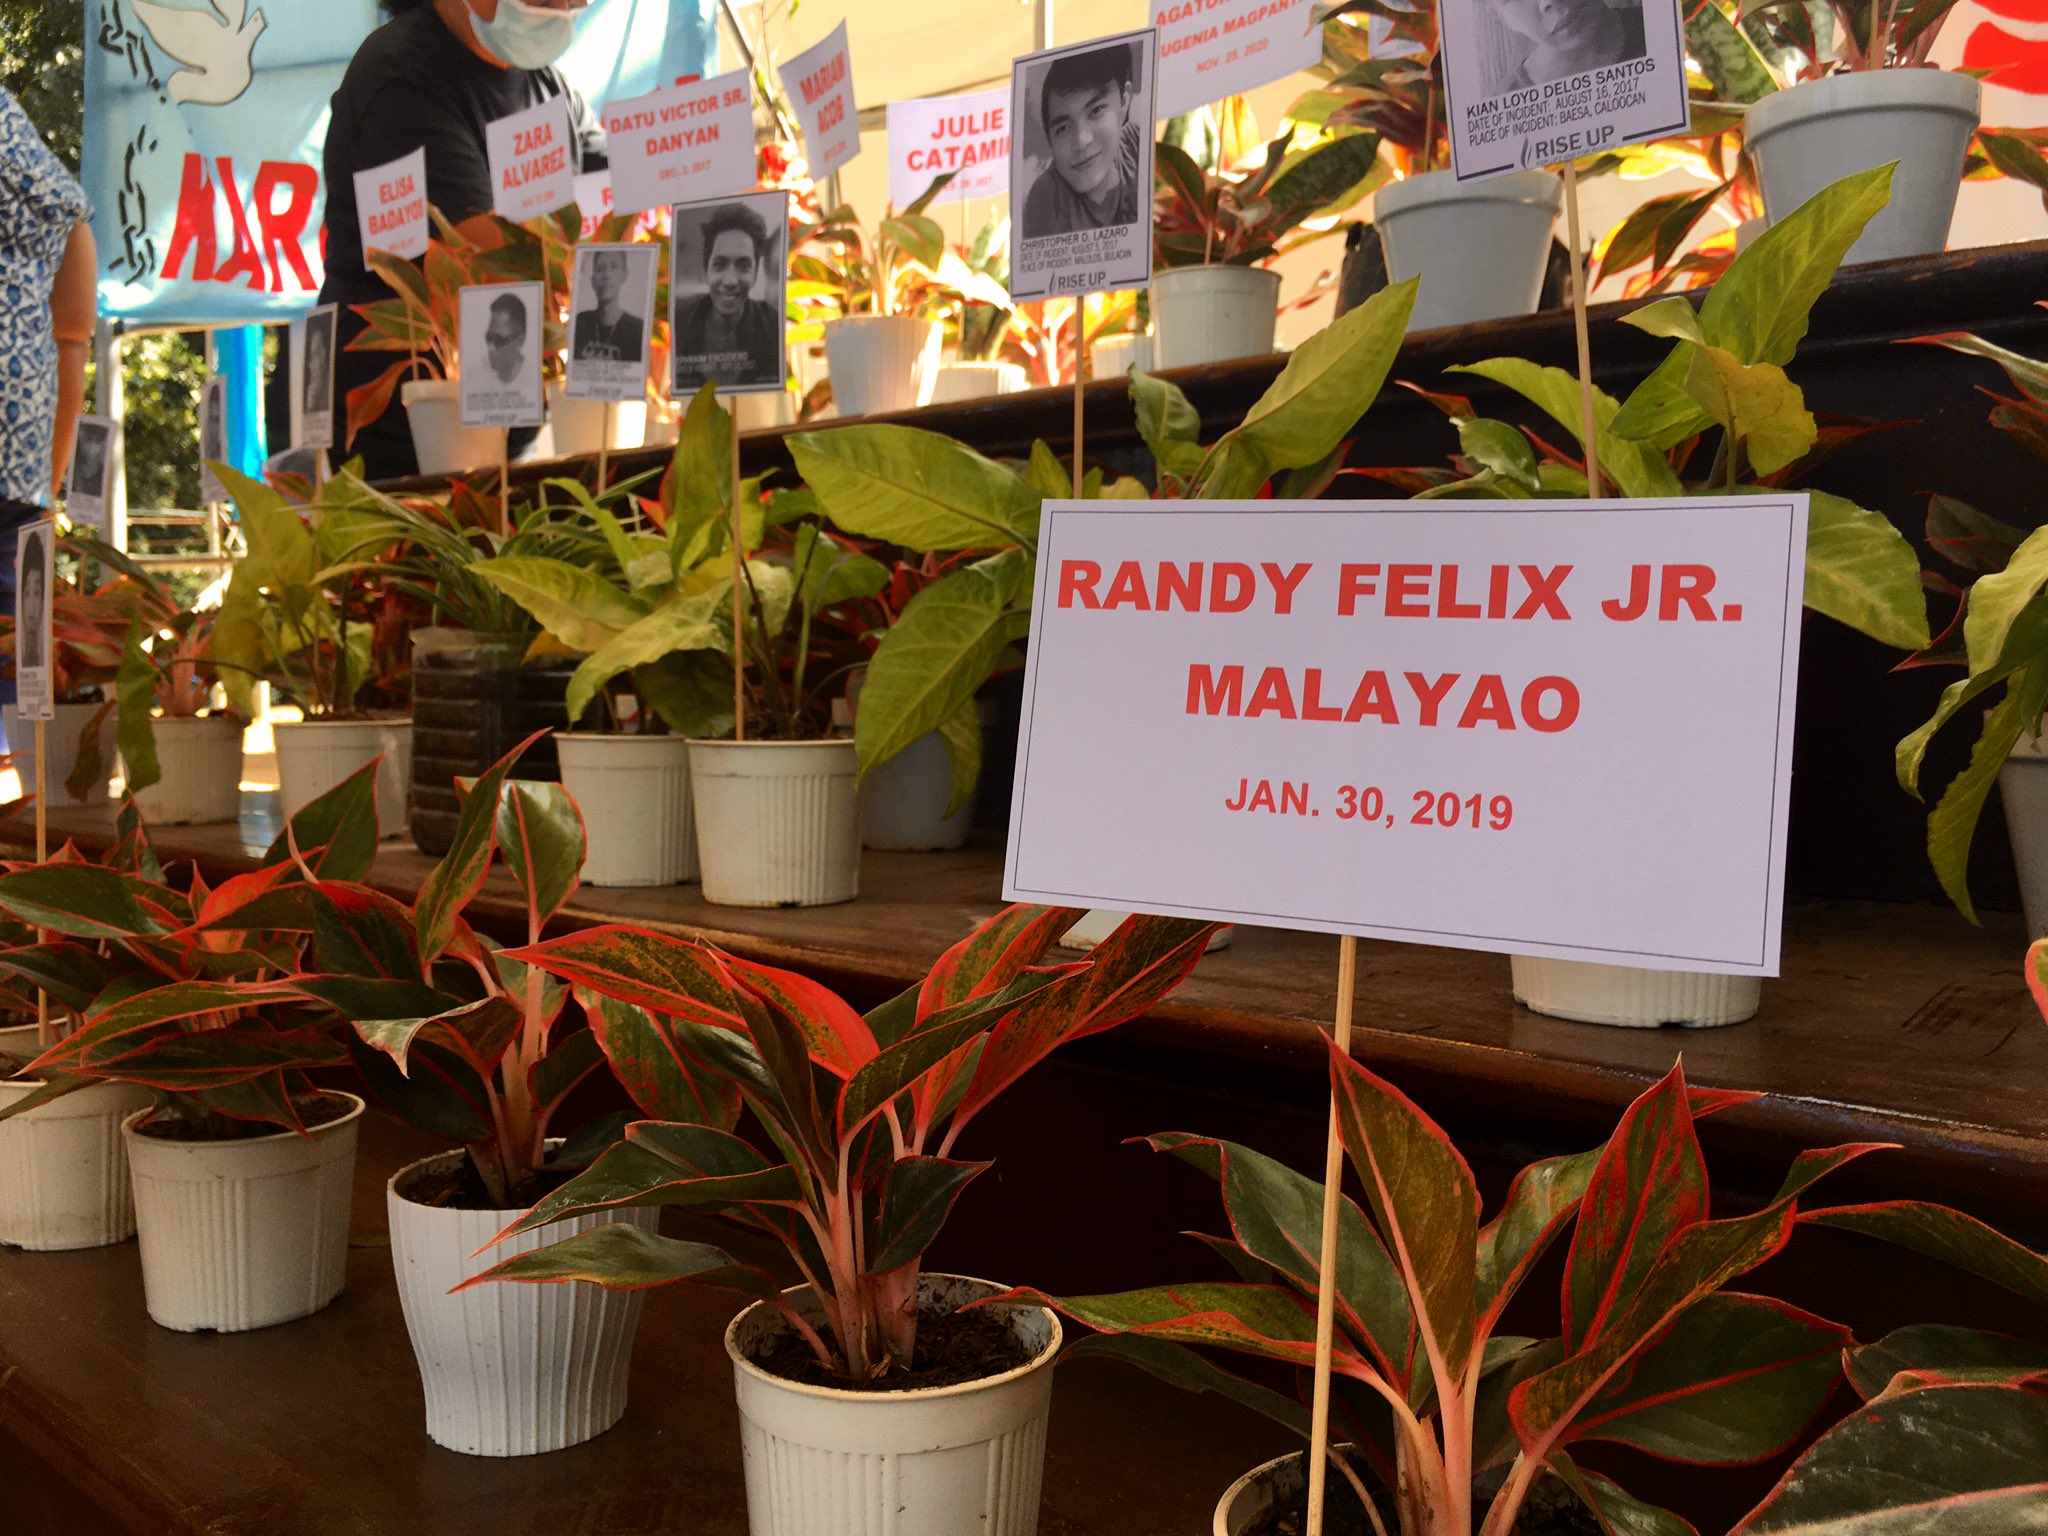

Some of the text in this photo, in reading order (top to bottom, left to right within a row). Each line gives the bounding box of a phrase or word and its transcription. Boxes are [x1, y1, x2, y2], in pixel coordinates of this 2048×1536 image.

[1156, 0, 1229, 27] AGATO
[1160, 26, 1218, 58] UGENIA
[1466, 58, 1656, 119] KIAN LOYD DELOS SANTOS
[1468, 115, 1491, 134] DATE
[1492, 113, 1505, 128] OF
[1506, 100, 1551, 123] INCIDENT:
[1556, 88, 1593, 111] AUGUST
[1614, 77, 1640, 96] 2017
[610, 111, 655, 134] DATU
[660, 95, 719, 124] VICTOR
[931, 108, 1004, 140] JULIE
[1469, 91, 1647, 147] PLACE OF INCIDENT: BAESA, CALOOCAN
[513, 121, 553, 156] ZARA
[646, 124, 719, 157] DANYAN
[1535, 132, 1582, 159] RISE
[1586, 125, 1615, 147] UP
[503, 146, 566, 190] ALVAREZ
[379, 175, 415, 205] ELISA
[1020, 233, 1079, 252] CHRISTOPHER
[1093, 227, 1128, 241] LAZARO
[1058, 271, 1106, 289] RISE UP
[1057, 559, 1743, 623] RANDY FELIX JR.
[1185, 663, 1581, 734] MALAYAO
[1224, 777, 1514, 832] JAN. 30, 2019
